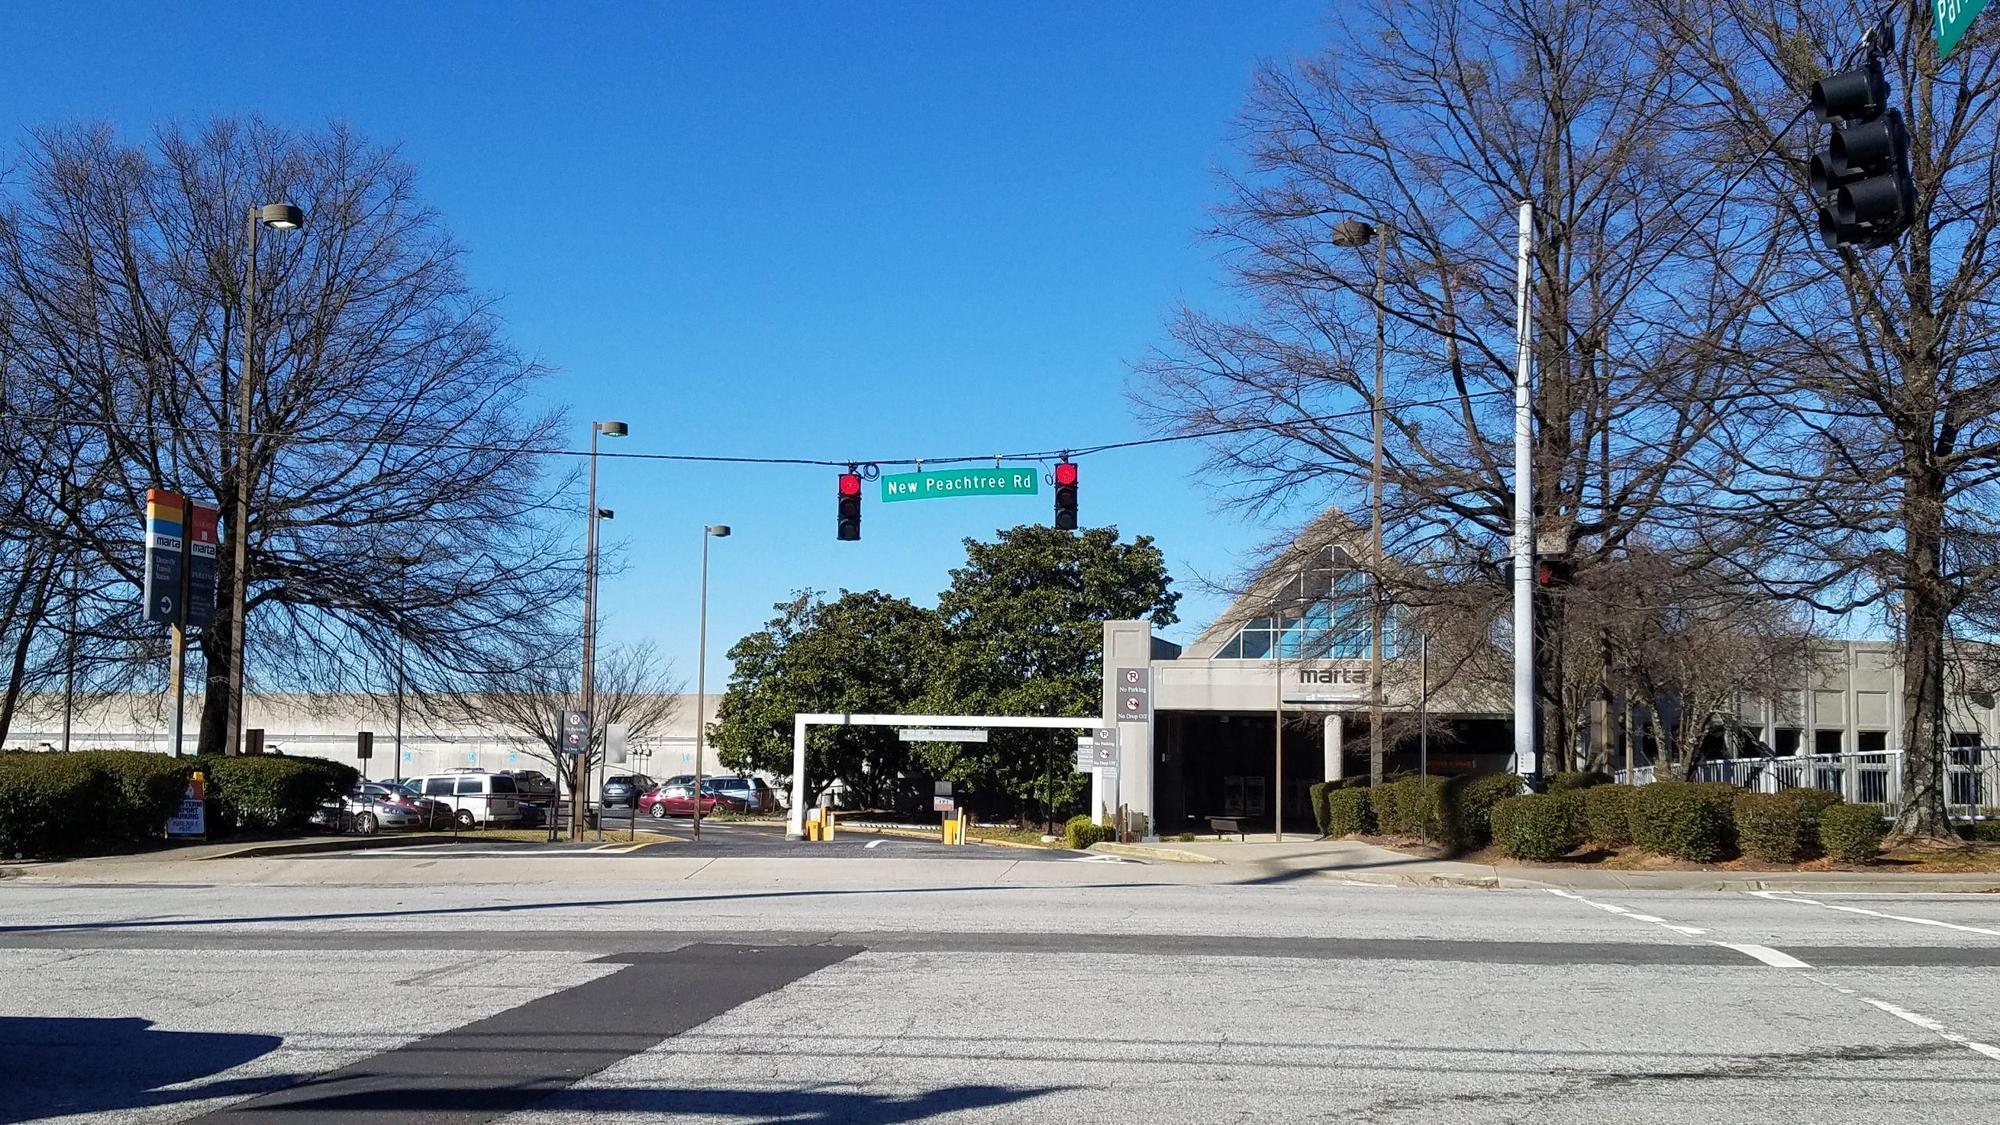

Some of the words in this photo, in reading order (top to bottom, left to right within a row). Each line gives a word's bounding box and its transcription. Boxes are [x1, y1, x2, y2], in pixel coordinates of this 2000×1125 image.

[888, 481, 917, 495] New
[926, 476, 1006, 492] Peachtree
[1013, 474, 1031, 488] Rd
[156, 536, 181, 549] marta
[192, 543, 215, 556] marta
[1300, 668, 1367, 684] marta
[1128, 686, 1147, 694] Parking
